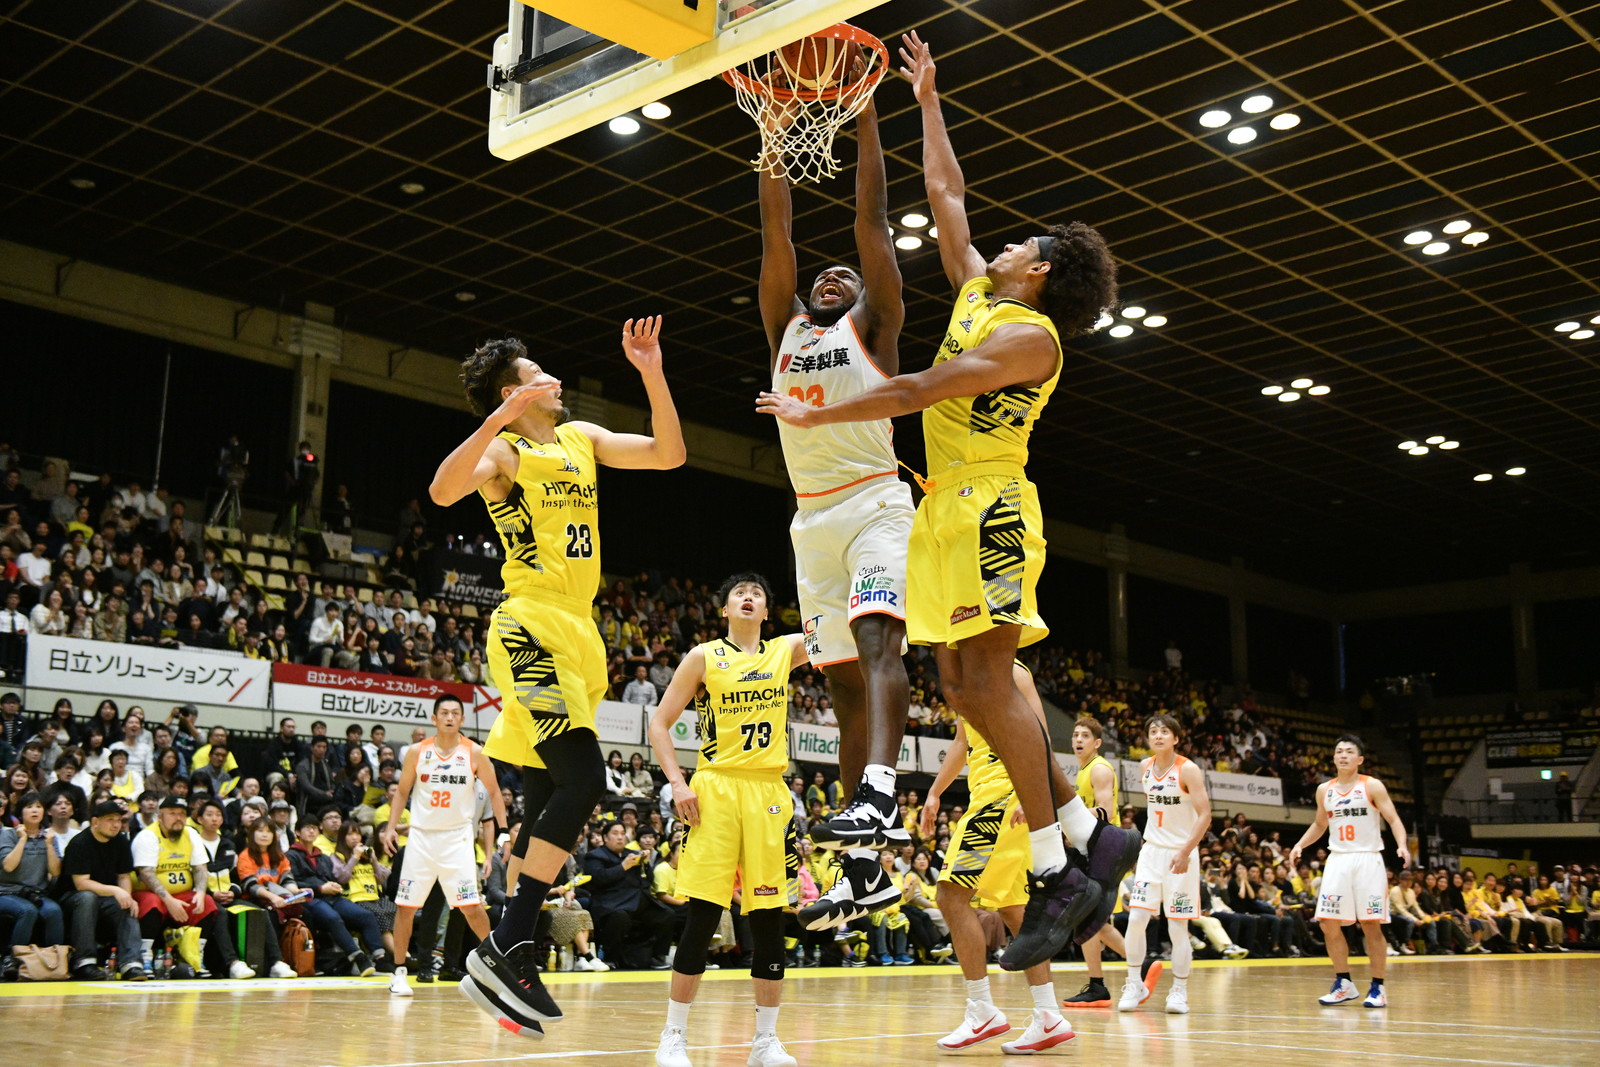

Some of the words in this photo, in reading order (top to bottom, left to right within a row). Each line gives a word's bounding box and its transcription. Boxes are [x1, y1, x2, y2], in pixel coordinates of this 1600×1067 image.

[789, 347, 851, 373] 三幸製菓
[566, 523, 593, 558] 23
[49, 647, 240, 688] 日立ソリューションズ
[306, 670, 445, 694] 日立エレベーター・エスカレーター
[721, 685, 785, 704] HITACHI
[320, 693, 428, 719] 日立ビルシステム
[719, 704, 753, 715] Inspire
[741, 721, 772, 751] 73
[431, 774, 467, 785] 三幸製菓
[430, 790, 452, 808] 32
[1154, 810, 1164, 828] 7
[1334, 807, 1368, 817] 三幸製菓
[1338, 825, 1355, 841] 18
[168, 872, 186, 884] 34
